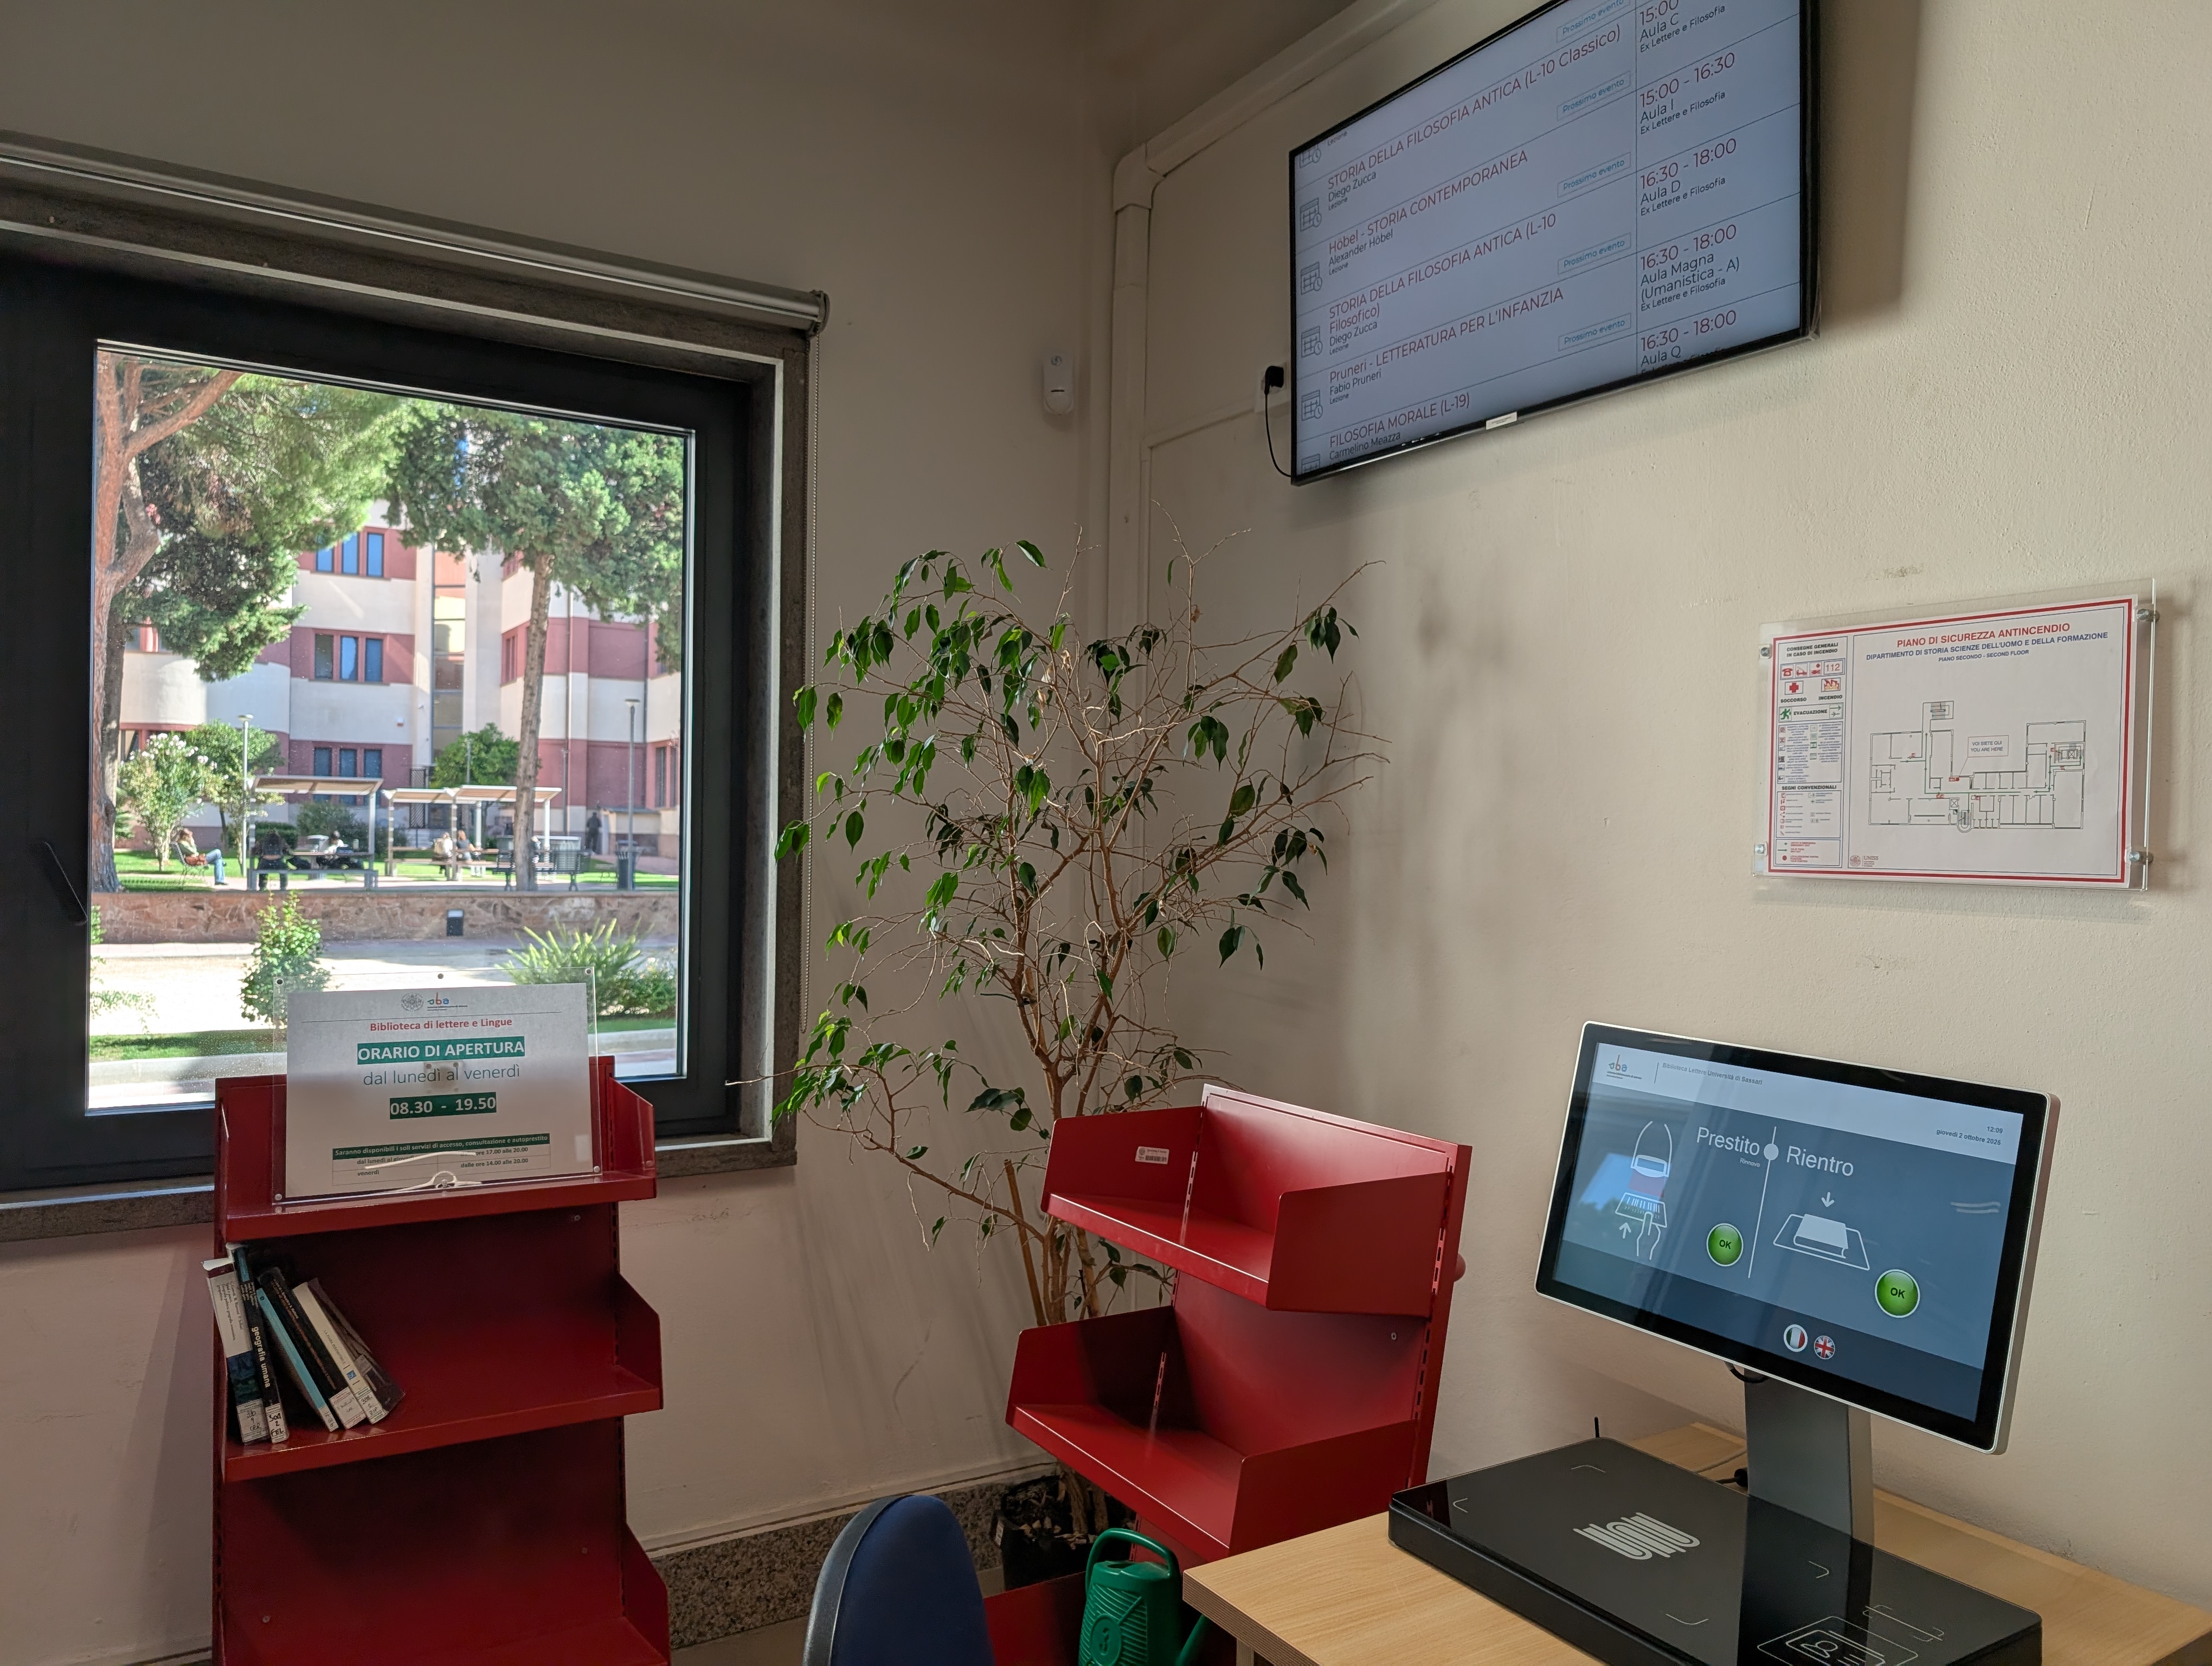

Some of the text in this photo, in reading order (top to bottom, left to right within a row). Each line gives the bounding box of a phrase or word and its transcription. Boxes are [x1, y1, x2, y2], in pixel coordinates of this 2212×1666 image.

[1640, 13, 1679, 42] Aula C
[1640, 44, 1650, 53] Ex
[1651, 29, 1680, 47] Lettere
[1690, 5, 1725, 30] Filosofia
[1640, 79, 1679, 107] 15:00
[1694, 52, 1735, 83] 16:30
[1328, 24, 1621, 189] STORIA DELLA FILOSOFIA ANTICA (L-10 Classico)
[1641, 102, 1667, 124] Aula
[1641, 162, 1679, 190] 16:30
[1693, 138, 1736, 168] 18:00
[1329, 172, 1376, 202] Diego Zucca
[1641, 180, 1681, 206] Aula D
[1329, 230, 1358, 254] Höbel
[1368, 208, 1407, 235] STORIA
[1410, 150, 1528, 215] CONTEMPORANEA
[1329, 229, 1393, 267] Alexander Höbel
[1564, 239, 1625, 268] Prossimo evento
[1641, 246, 1679, 270] 16:30
[1693, 225, 1737, 252] 18:00
[1330, 214, 1556, 319] STORIA DELLA FILOSOFIA ANTICA (L-10
[1641, 253, 1714, 286] Aula Magna
[1641, 267, 1714, 303] (Umanistica
[1726, 257, 1739, 274] A)
[1330, 303, 1380, 334] Filosofico)
[1330, 359, 1366, 383] Pruneri
[1377, 327, 1456, 367] LETTERATURA
[1460, 316, 1484, 336] PER
[1488, 287, 1563, 326] L'INFANZIA
[1641, 351, 1667, 367] Aula
[1671, 346, 1681, 358] Q
[1330, 369, 1381, 396] Fabio Pruneri
[1330, 393, 1349, 405] Lezione
[1330, 392, 1470, 448] FILOSOFIA MORALE (L-19)
[1330, 432, 1400, 460] Carmelino Meazza
[1866, 650, 1914, 661] DIPARTIMENTO
[1924, 647, 1949, 655] STORIA
[1950, 644, 1980, 652] SCIENZE
[1982, 640, 2023, 650] DELL'UOMO
[2057, 632, 2108, 643] FORMAZIONE
[1897, 623, 2070, 648] PIANO DI SICUREZZA ANTINCENDIO
[1825, 663, 1840, 671] 112
[370, 1022, 421, 1031] Biblioteca
[423, 1020, 433, 1029] di
[436, 1019, 469, 1028] lettere
[481, 1018, 512, 1027] Lingue
[358, 1041, 524, 1060] ORARIO DI APERTURA
[363, 1064, 520, 1085] dal lunedì al venerdì
[1663, 1062, 1687, 1072] Biblioteca
[1688, 1067, 1706, 1075] Lettere
[1708, 1070, 1734, 1080] Università
[1742, 1076, 1762, 1085] Sassari
[390, 1100, 433, 1115] 08.30
[455, 1097, 496, 1111] 19.50
[1697, 1126, 1760, 1156] Prestito
[1936, 1129, 1958, 1138] giovedì
[363, 1145, 395, 1155] disponibili
[1740, 1158, 1760, 1167] Rinnovo
[1787, 1145, 1854, 1176] Rientro
[1719, 1239, 1732, 1250] OK
[1890, 1287, 1906, 1299] OK
[252, 1327, 270, 1388] geografia umana
